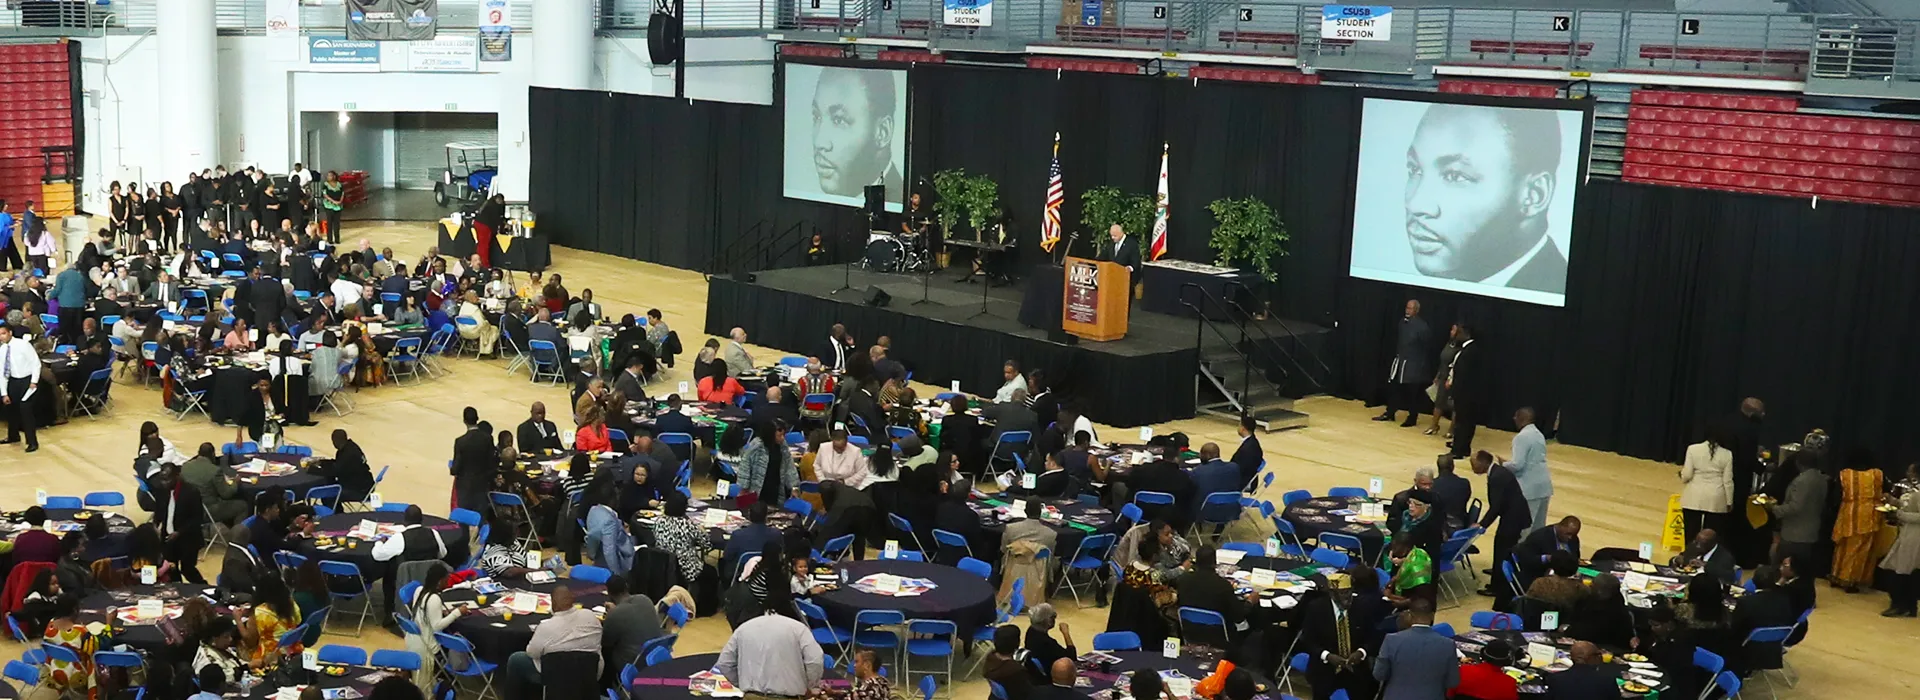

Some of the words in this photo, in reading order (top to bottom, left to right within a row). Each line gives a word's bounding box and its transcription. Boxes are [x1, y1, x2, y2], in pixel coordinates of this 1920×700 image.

[1156, 8, 1162, 18] J
[1241, 10, 1248, 20] K
[1342, 7, 1371, 16] CSUSB
[1337, 18, 1376, 27] STUDENT
[1554, 18, 1564, 30] K
[1684, 21, 1694, 33] L
[1337, 29, 1374, 37] SECTION
[1069, 266, 1098, 285] MLK
[1165, 641, 1176, 650] 20
